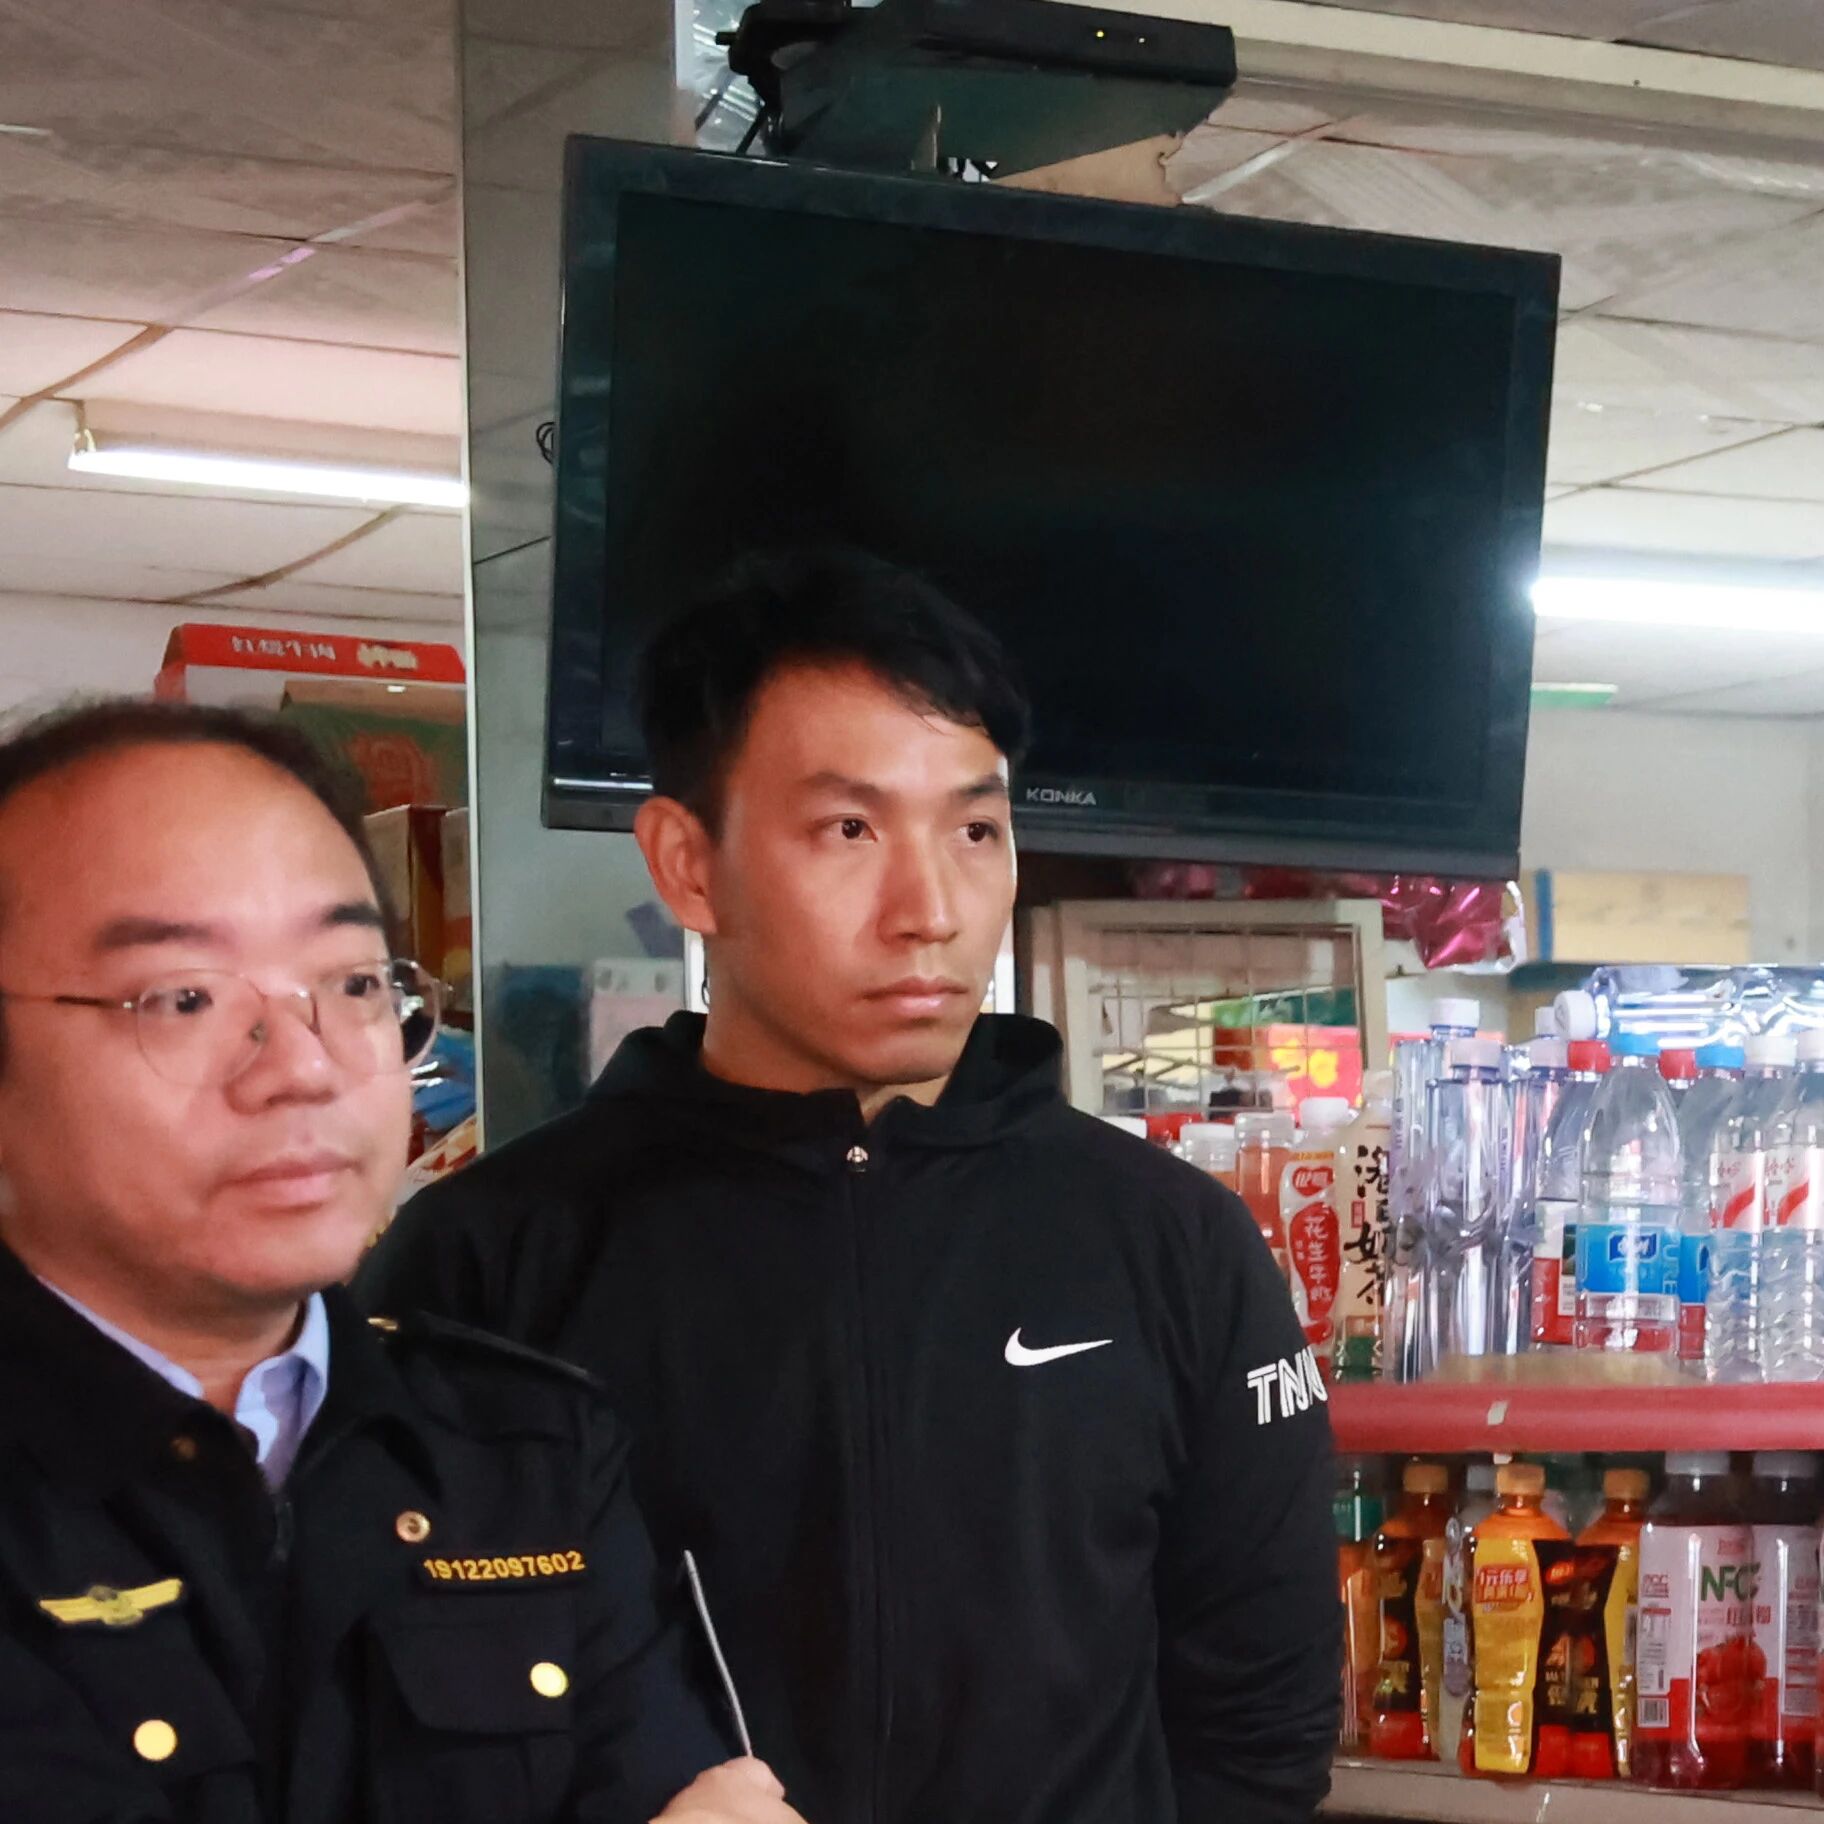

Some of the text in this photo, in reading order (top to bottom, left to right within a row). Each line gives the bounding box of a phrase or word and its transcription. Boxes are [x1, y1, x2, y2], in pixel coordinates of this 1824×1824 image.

[1026, 787, 1096, 806] KONKA
[423, 1550, 586, 1580] 19122097602
[1702, 1562, 1760, 1602] NFC
